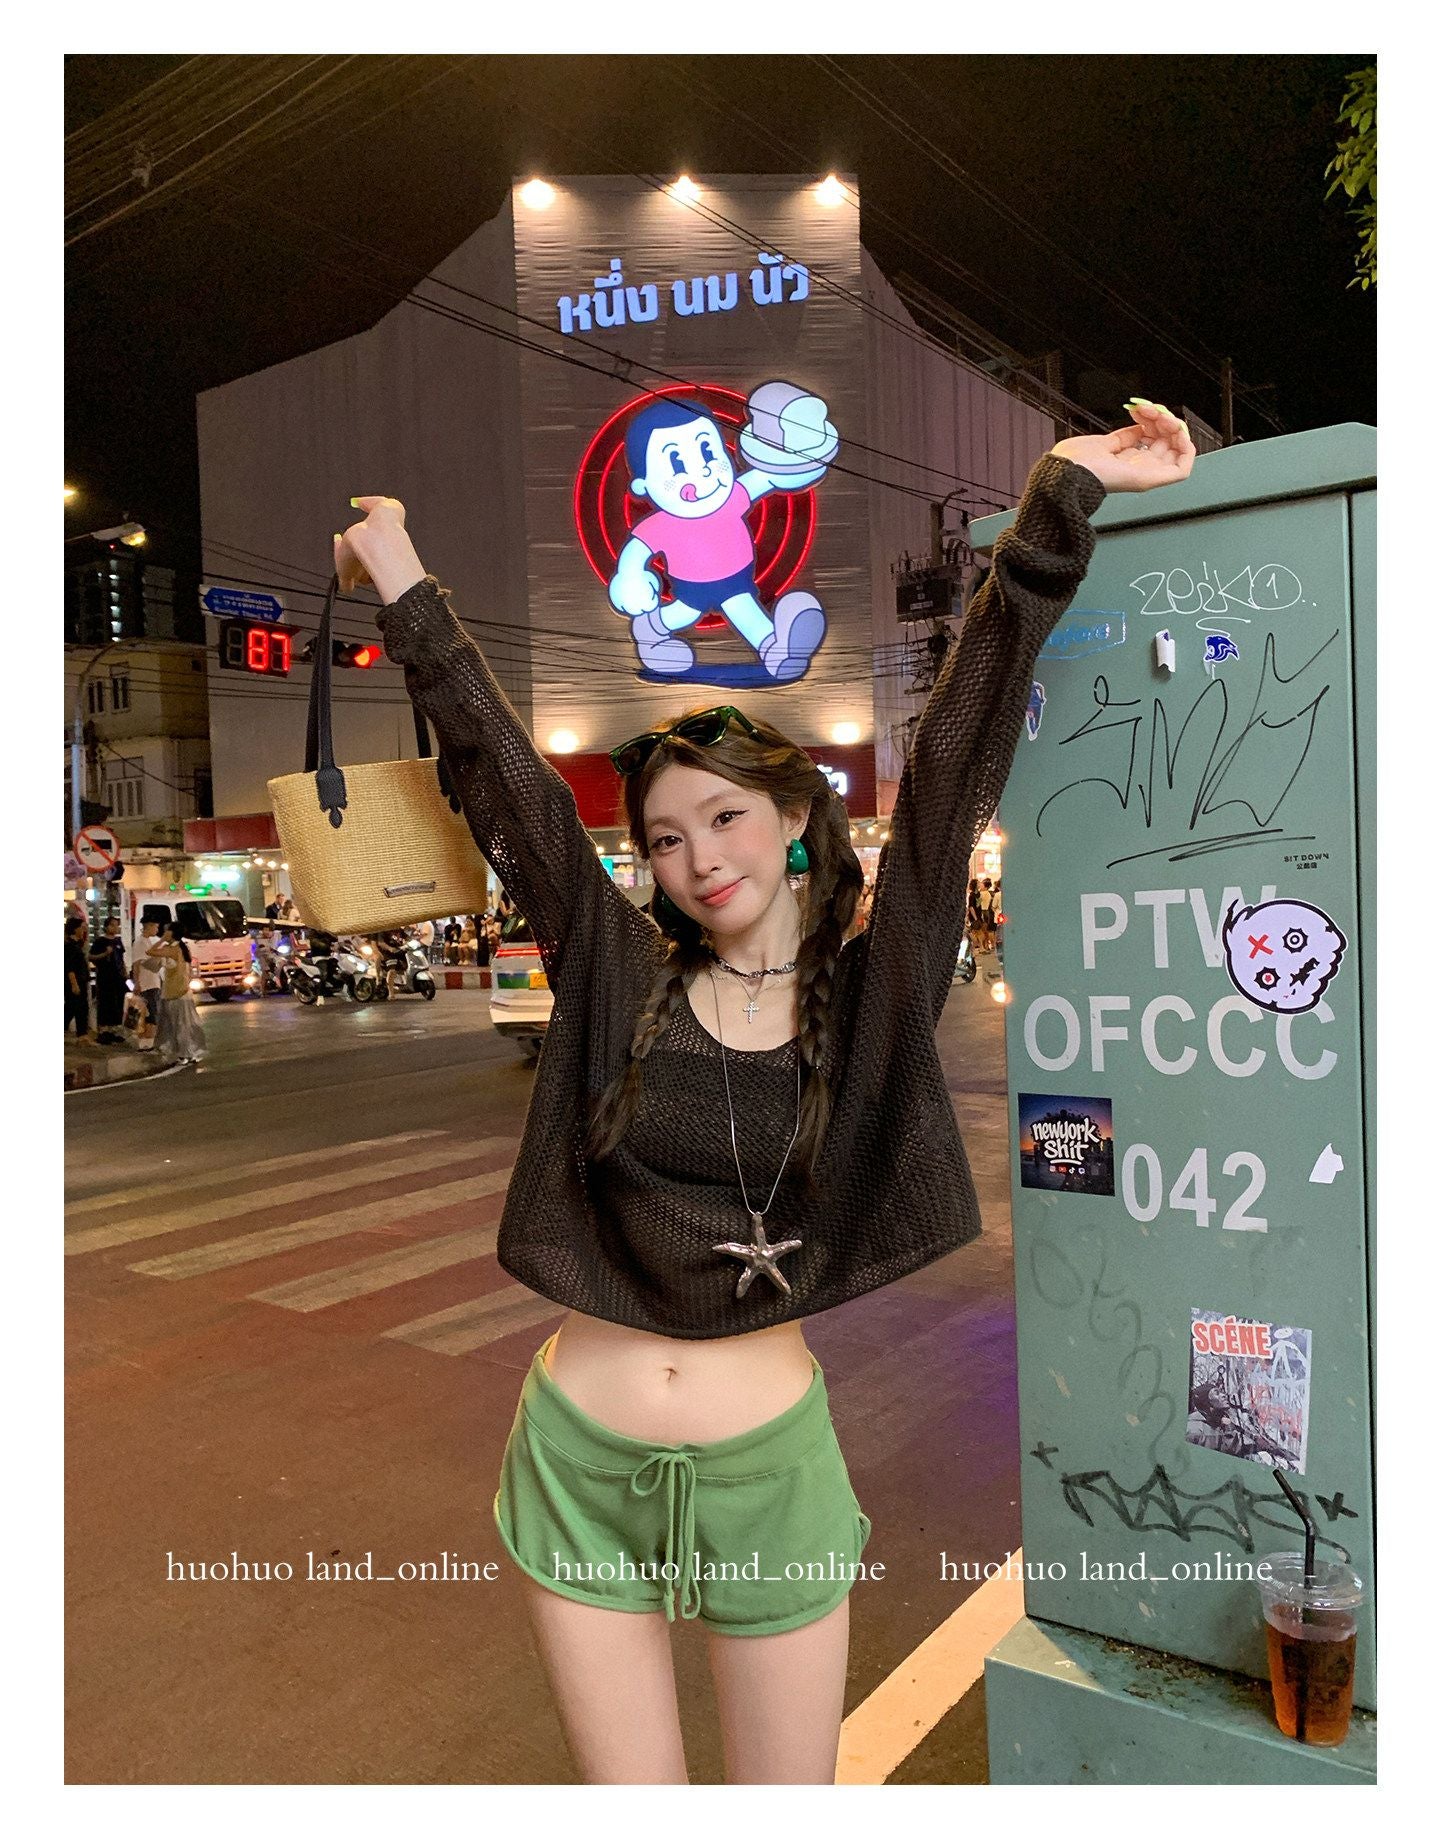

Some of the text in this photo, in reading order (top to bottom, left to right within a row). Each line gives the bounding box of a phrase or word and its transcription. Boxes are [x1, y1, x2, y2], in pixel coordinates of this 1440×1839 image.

[556, 258, 659, 334] หนึ่ง
[670, 272, 738, 317] นม
[247, 627, 292, 673] 87
[1301, 852, 1330, 861] DOWN
[1023, 995, 1339, 1081] OFCCC
[1032, 1117, 1100, 1144] newyork
[1121, 1143, 1270, 1234] 042
[1192, 1317, 1272, 1357] SCÉNE
